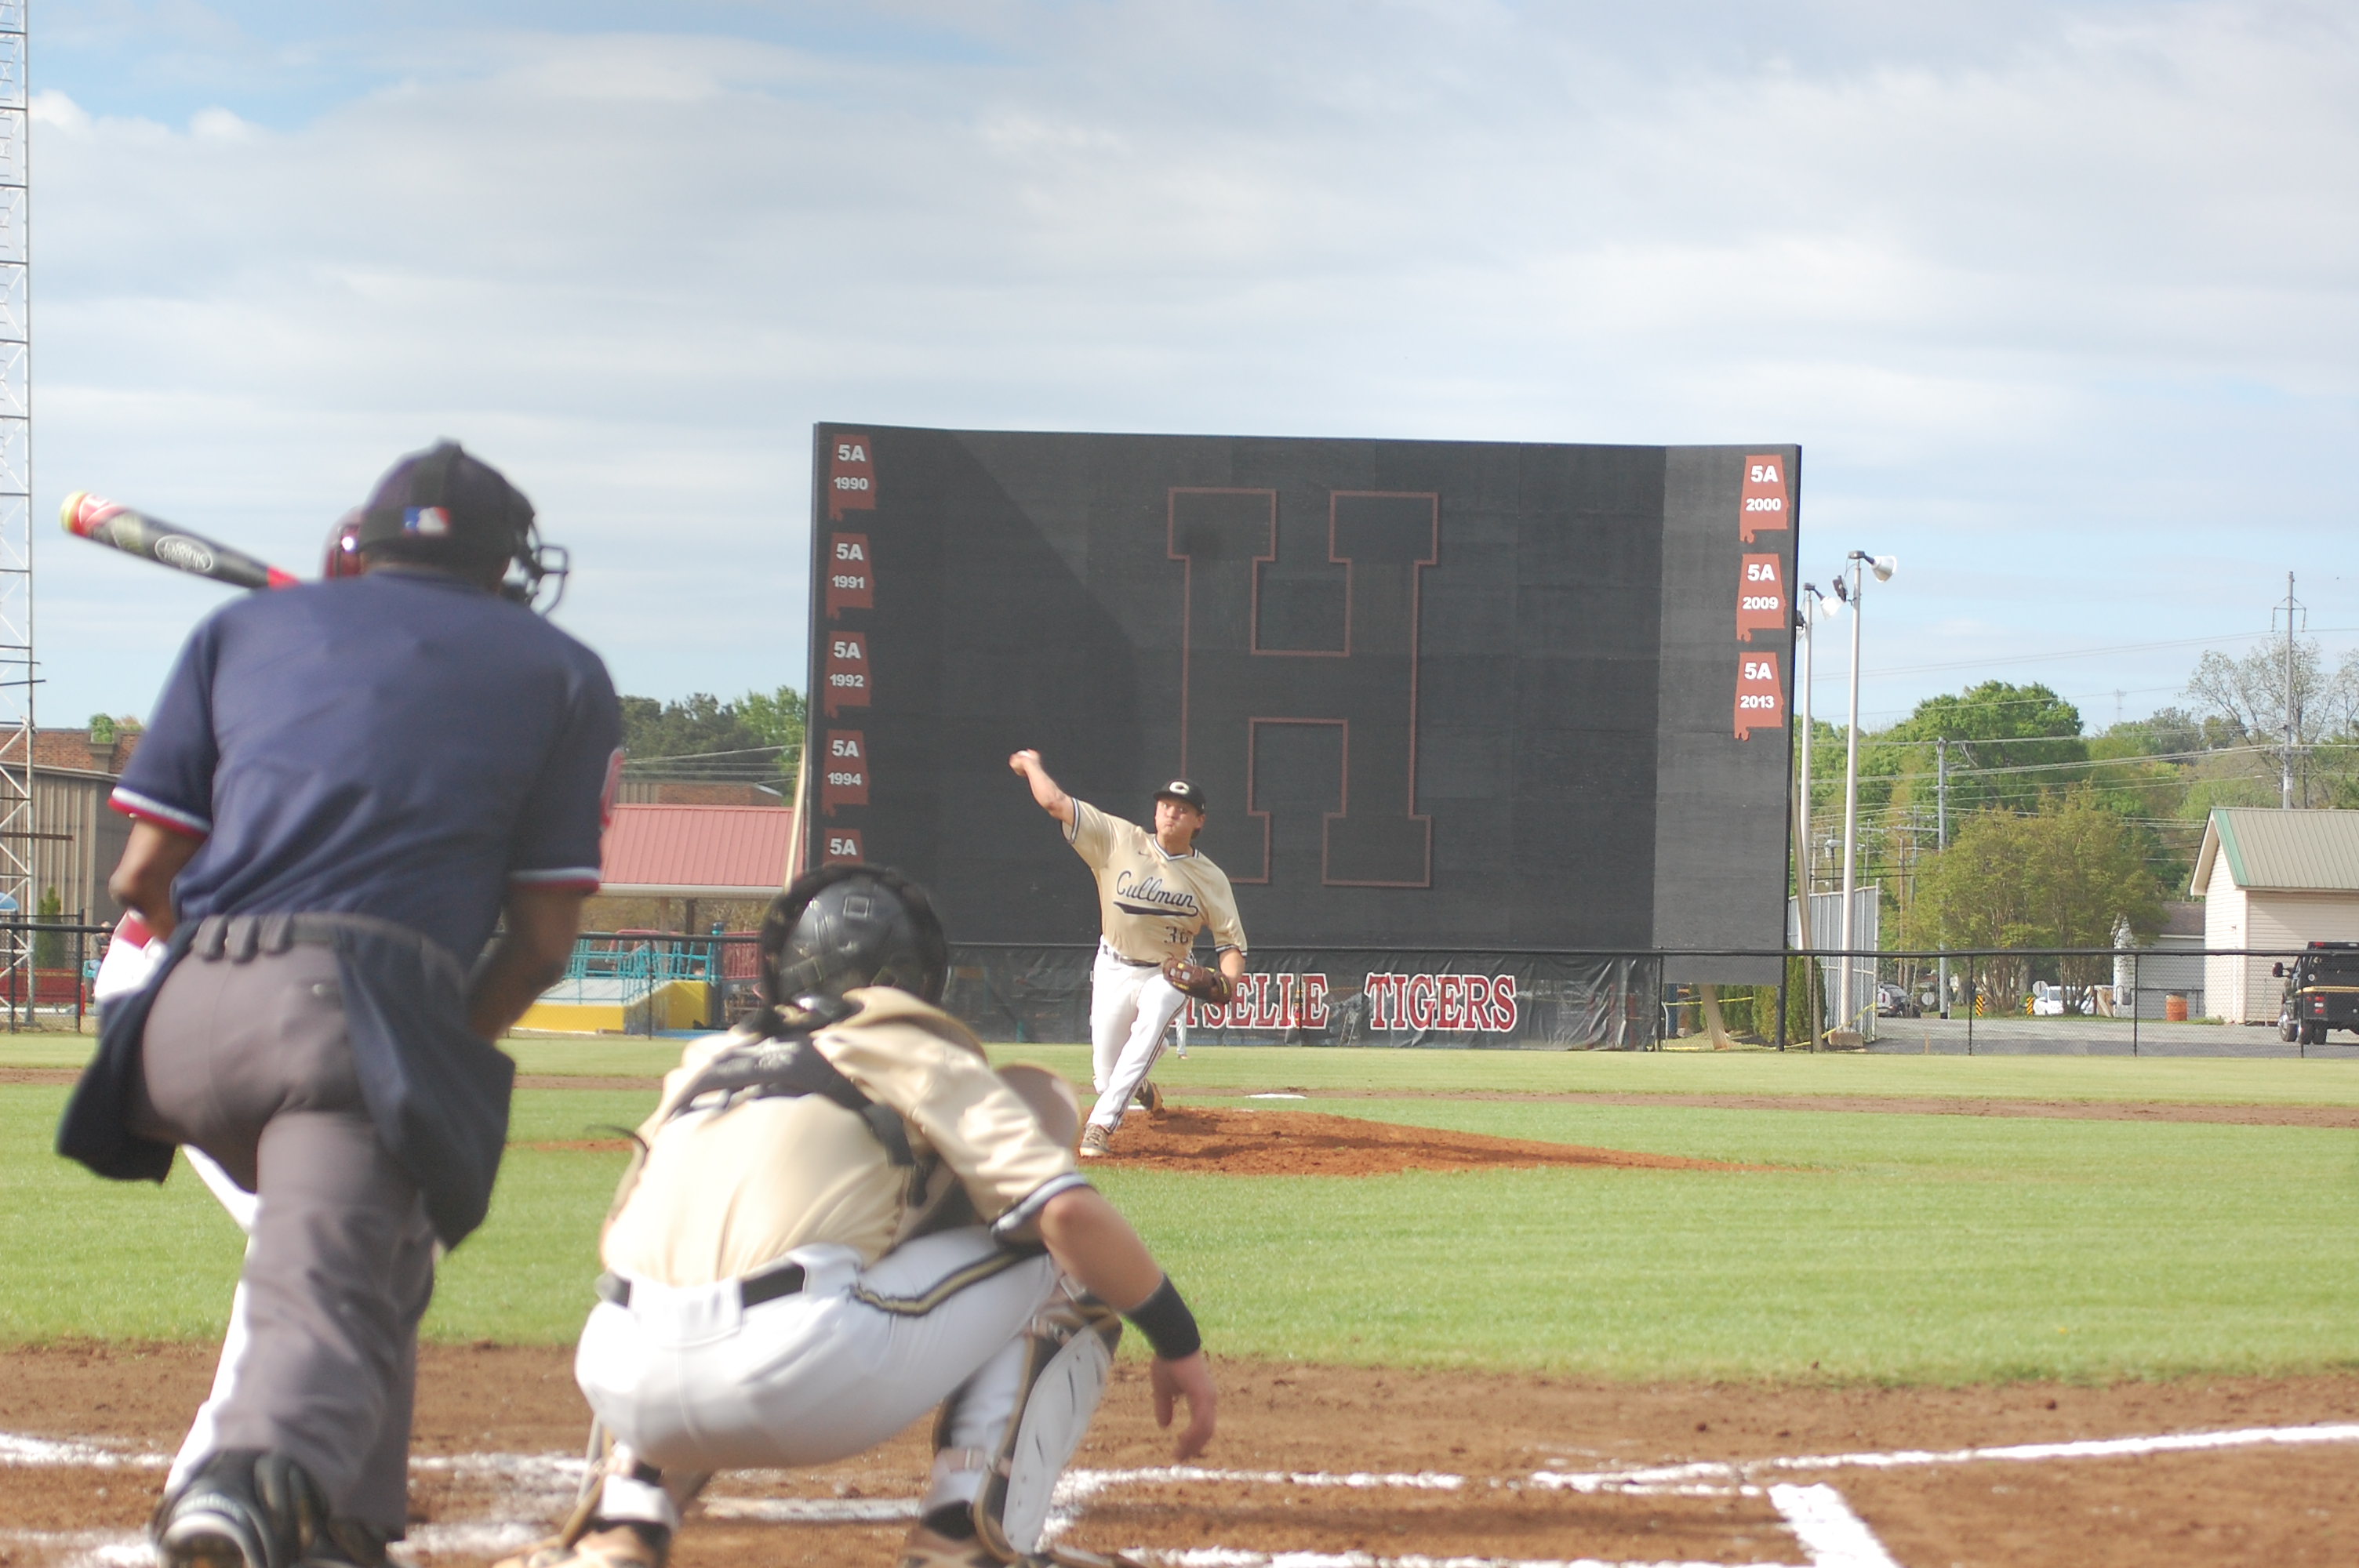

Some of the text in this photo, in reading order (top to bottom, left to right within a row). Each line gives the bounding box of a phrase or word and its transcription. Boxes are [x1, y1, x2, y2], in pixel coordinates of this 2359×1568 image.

[838, 444, 866, 462] 5A
[1750, 465, 1779, 483] 5A
[834, 477, 869, 491] 1990
[1746, 498, 1782, 512] 2000
[836, 543, 864, 561] 5A
[1747, 564, 1776, 582] 5A
[832, 575, 865, 590] 1991
[1742, 596, 1779, 610] 2009
[834, 641, 861, 659] 5A
[1744, 662, 1772, 680] 5A
[829, 673, 864, 688] 1992
[1739, 695, 1775, 709] 2013
[832, 739, 860, 757] 5A
[827, 772, 862, 786] 1994
[830, 838, 857, 856] 5A
[1116, 870, 1195, 909] Cullman
[1364, 972, 1517, 1033] TIGERS
